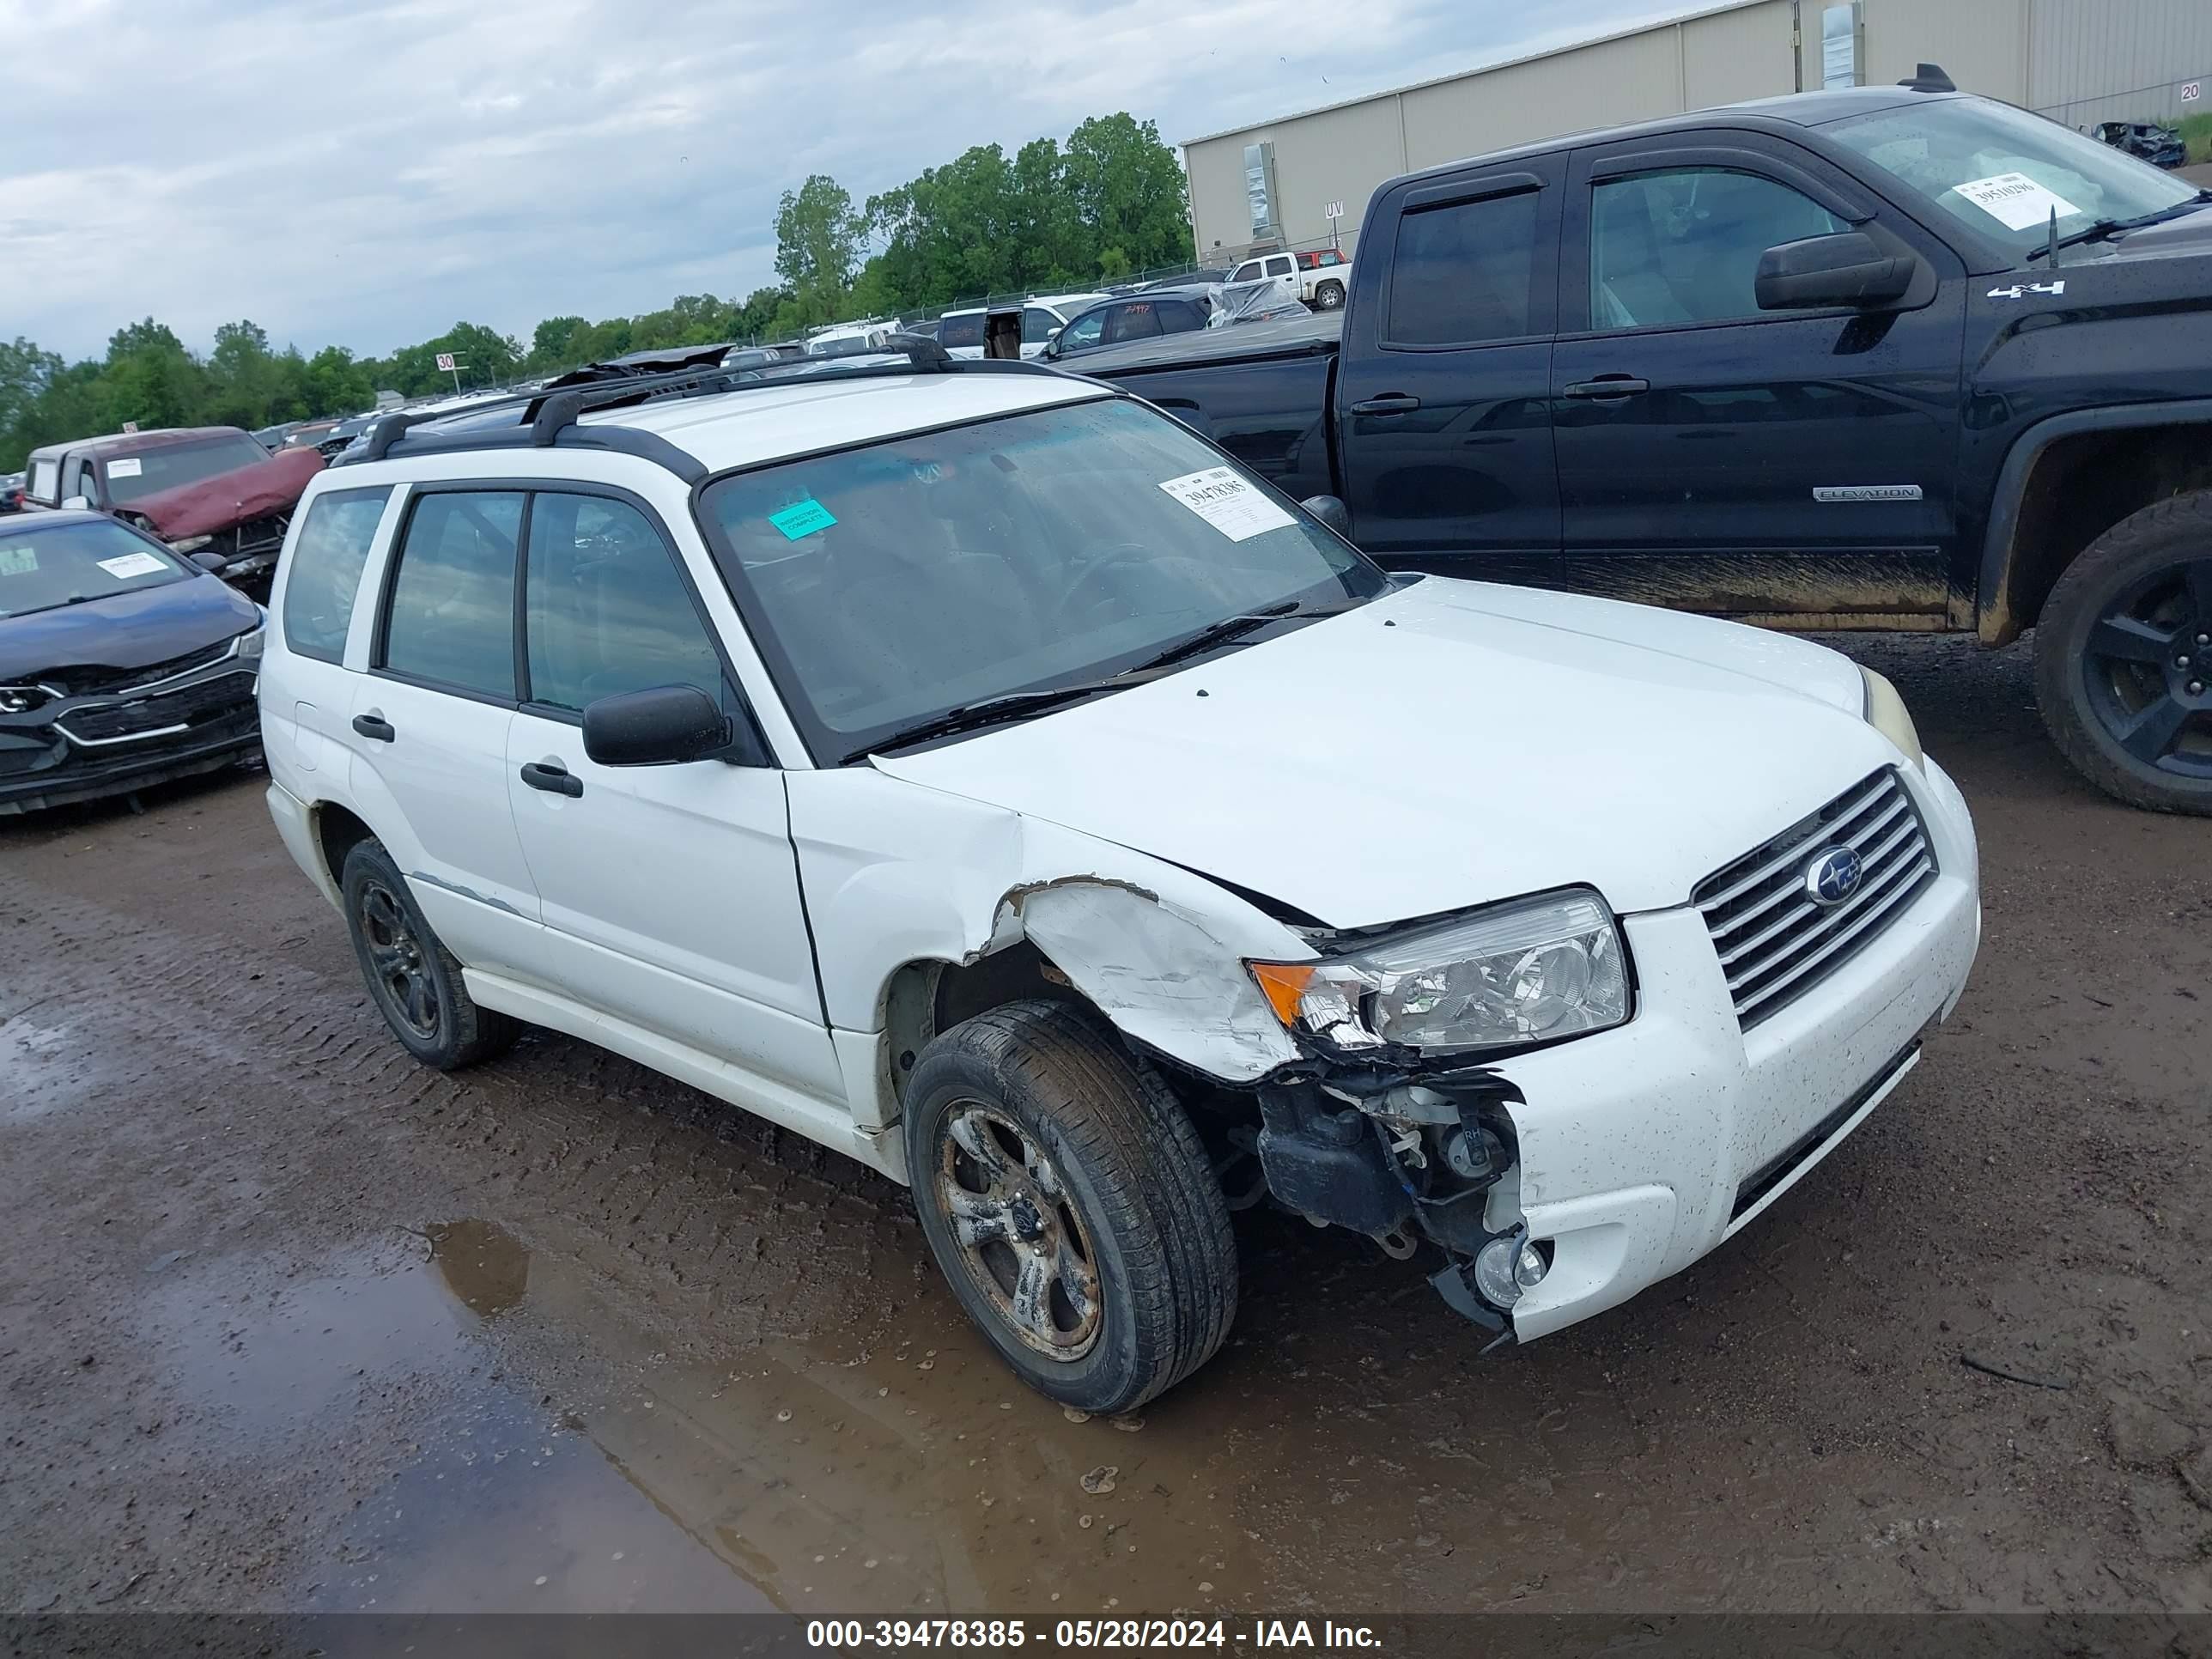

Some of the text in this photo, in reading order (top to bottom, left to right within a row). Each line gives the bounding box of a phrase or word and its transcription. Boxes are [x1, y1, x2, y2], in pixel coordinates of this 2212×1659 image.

[2183, 85, 2198, 100] 20
[1975, 182, 2036, 204] 39510296
[438, 356, 453, 368] 30
[1185, 480, 1247, 506] 39478385
[1820, 489, 1915, 498] ELEVATION
[787, 514, 825, 531] COMPLETE
[1464, 1127, 1480, 1141] RH
